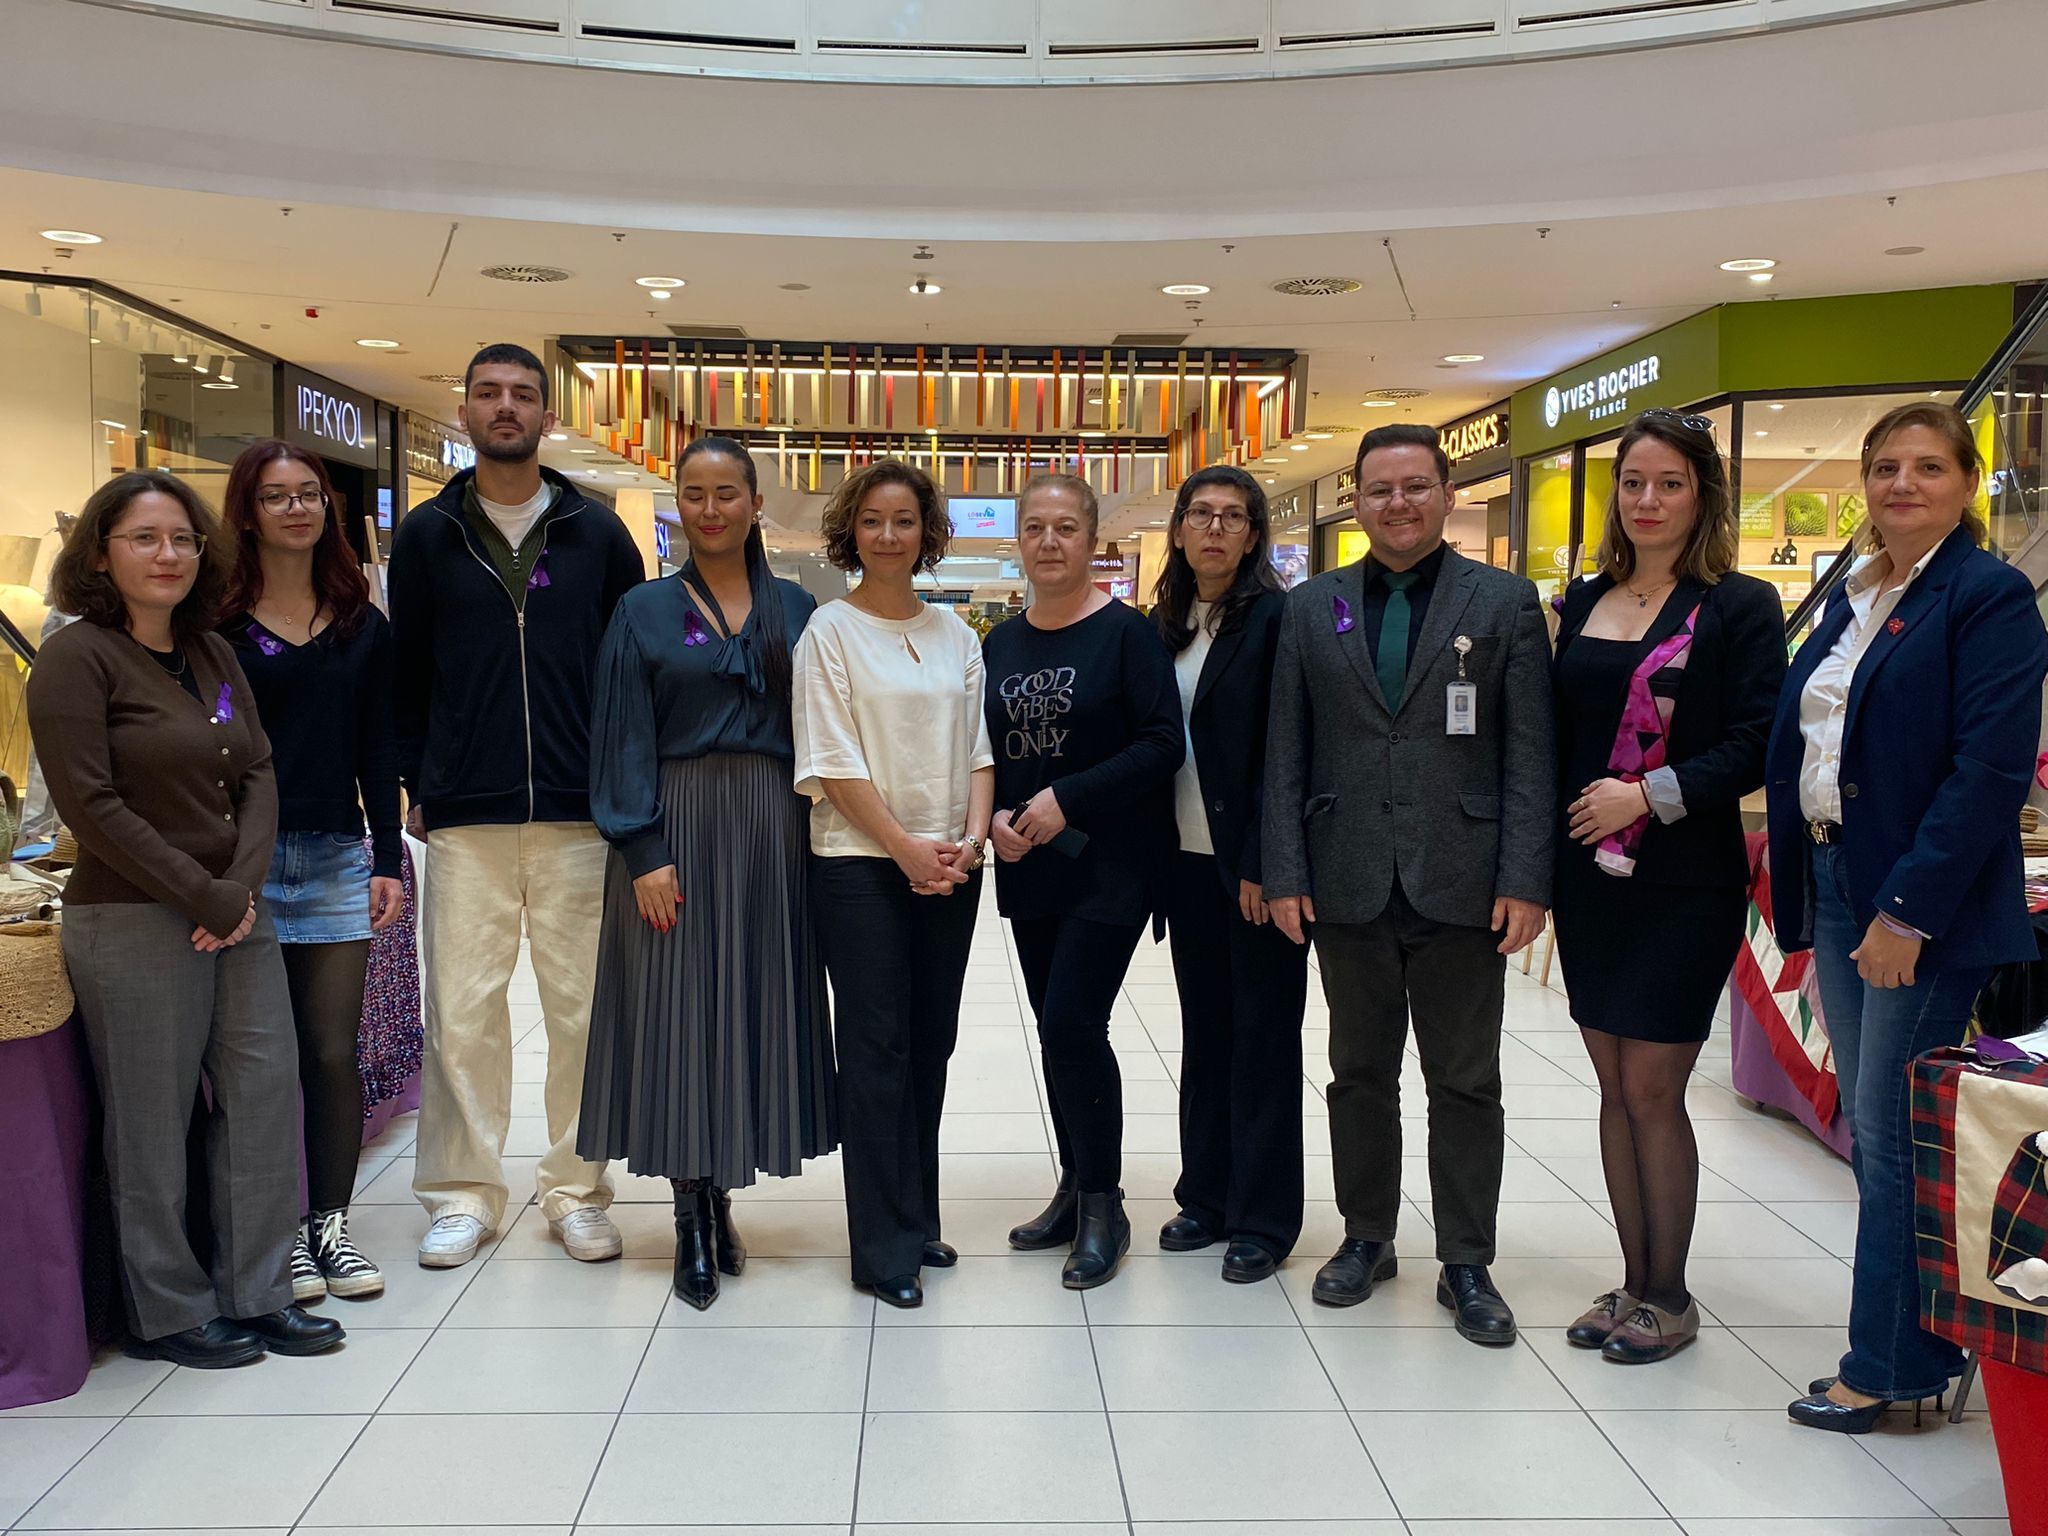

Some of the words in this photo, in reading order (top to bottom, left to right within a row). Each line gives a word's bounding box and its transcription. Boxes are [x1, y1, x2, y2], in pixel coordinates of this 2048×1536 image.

[1561, 380, 1596, 414] YVES
[1598, 355, 1659, 401] ROCHER
[297, 384, 365, 449] IPEKYOL
[1589, 397, 1628, 421] FRANCE
[1448, 413, 1498, 461] CLASSICS
[999, 666, 1076, 698] GOOD
[1001, 687, 1073, 731] VIBES
[1005, 721, 1070, 760] ONLY
